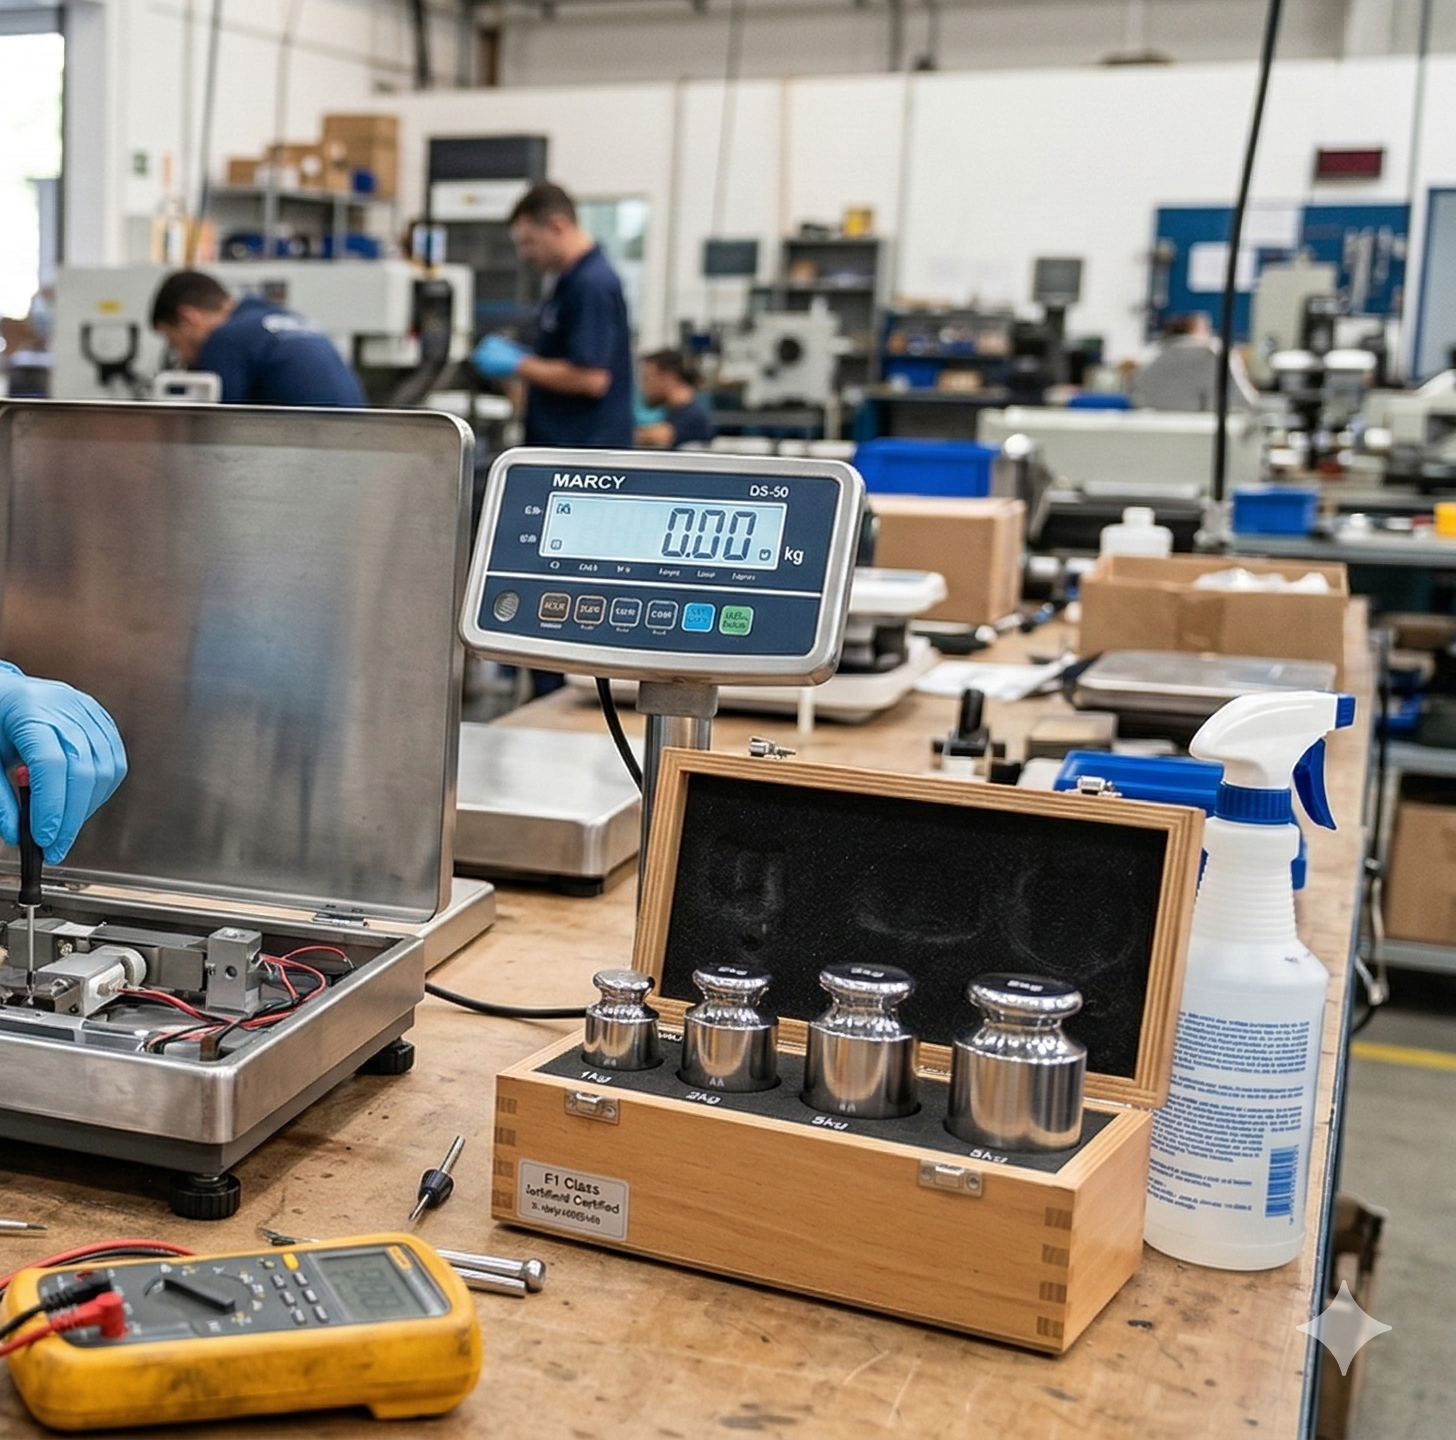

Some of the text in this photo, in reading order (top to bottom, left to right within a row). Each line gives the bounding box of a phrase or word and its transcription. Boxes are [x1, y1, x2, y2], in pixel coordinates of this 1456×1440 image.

[553, 473, 626, 490] MARCY
[749, 485, 789, 499] DS-50
[661, 507, 757, 561] 0.00
[784, 546, 804, 566] kg
